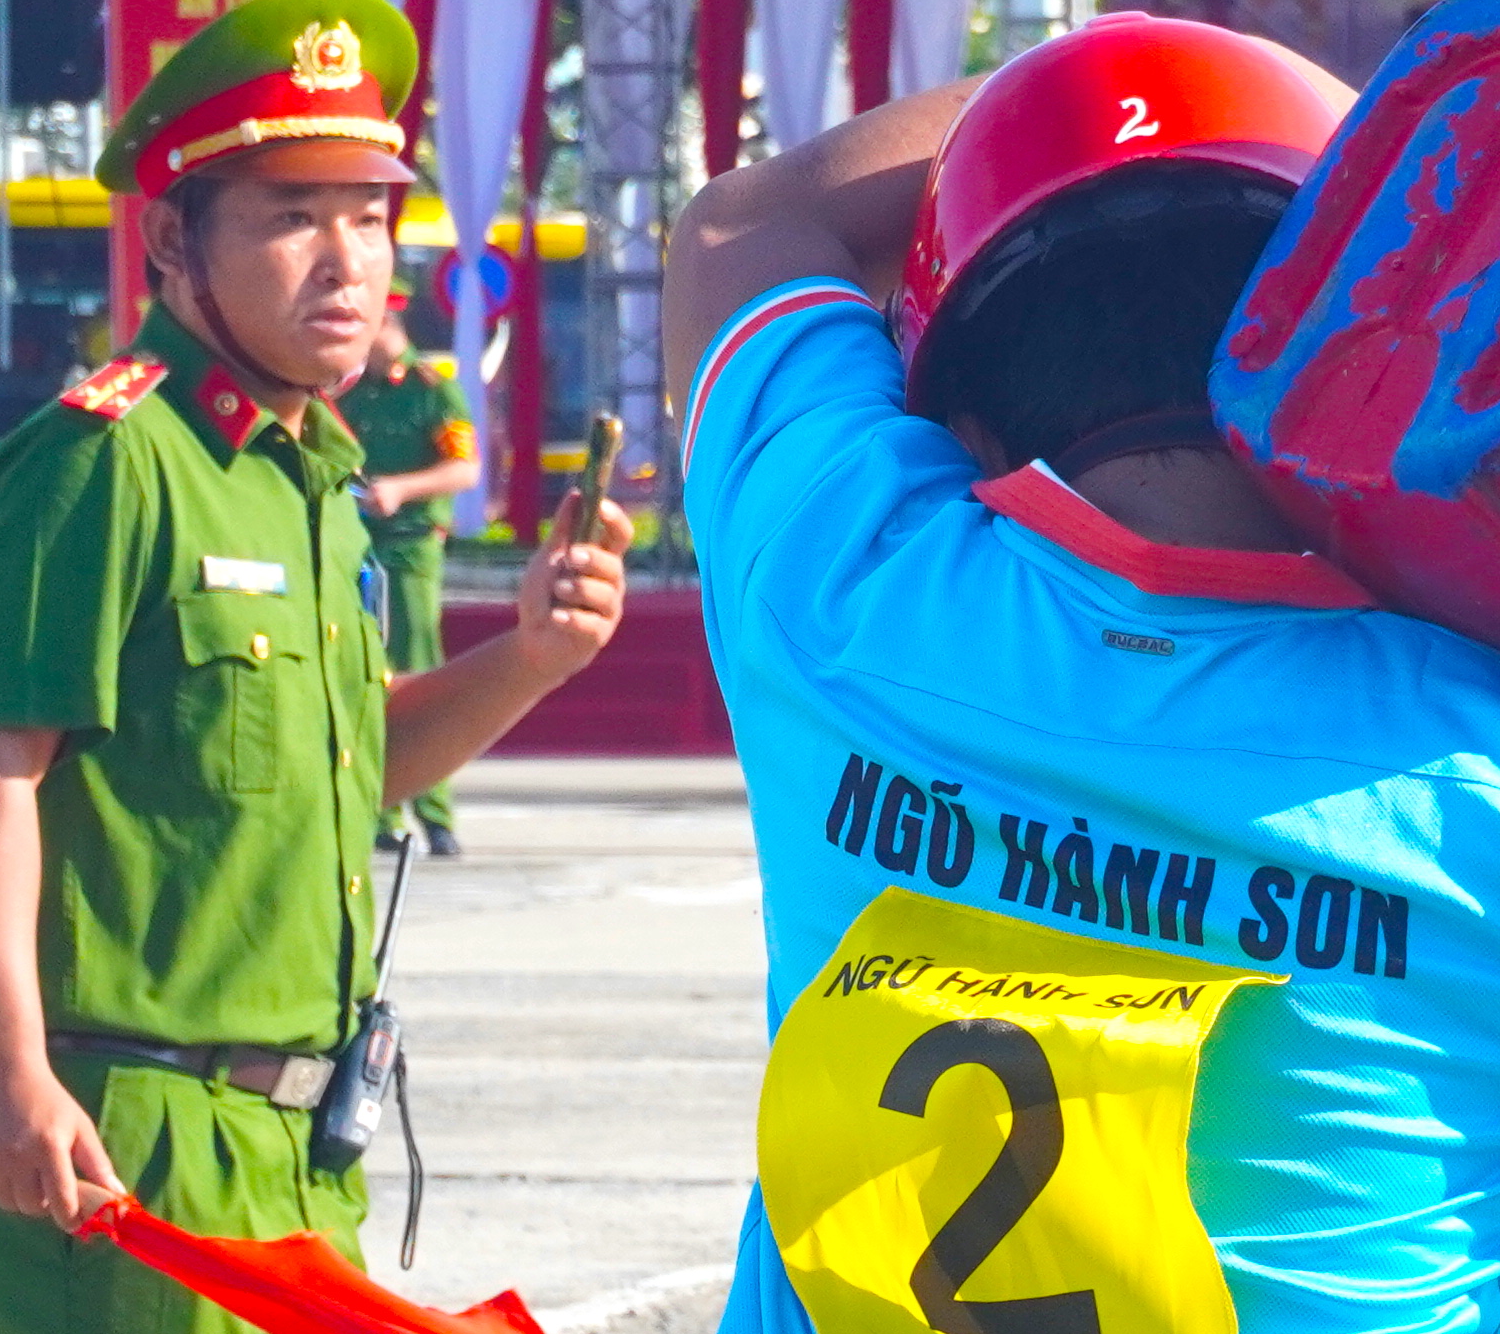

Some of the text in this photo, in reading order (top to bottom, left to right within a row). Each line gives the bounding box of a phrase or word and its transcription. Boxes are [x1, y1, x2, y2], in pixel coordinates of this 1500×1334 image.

[1114, 97, 1159, 144] 2
[825, 752, 1410, 980] NGŨ HÀNH SƠN
[823, 953, 936, 998] NGŨ
